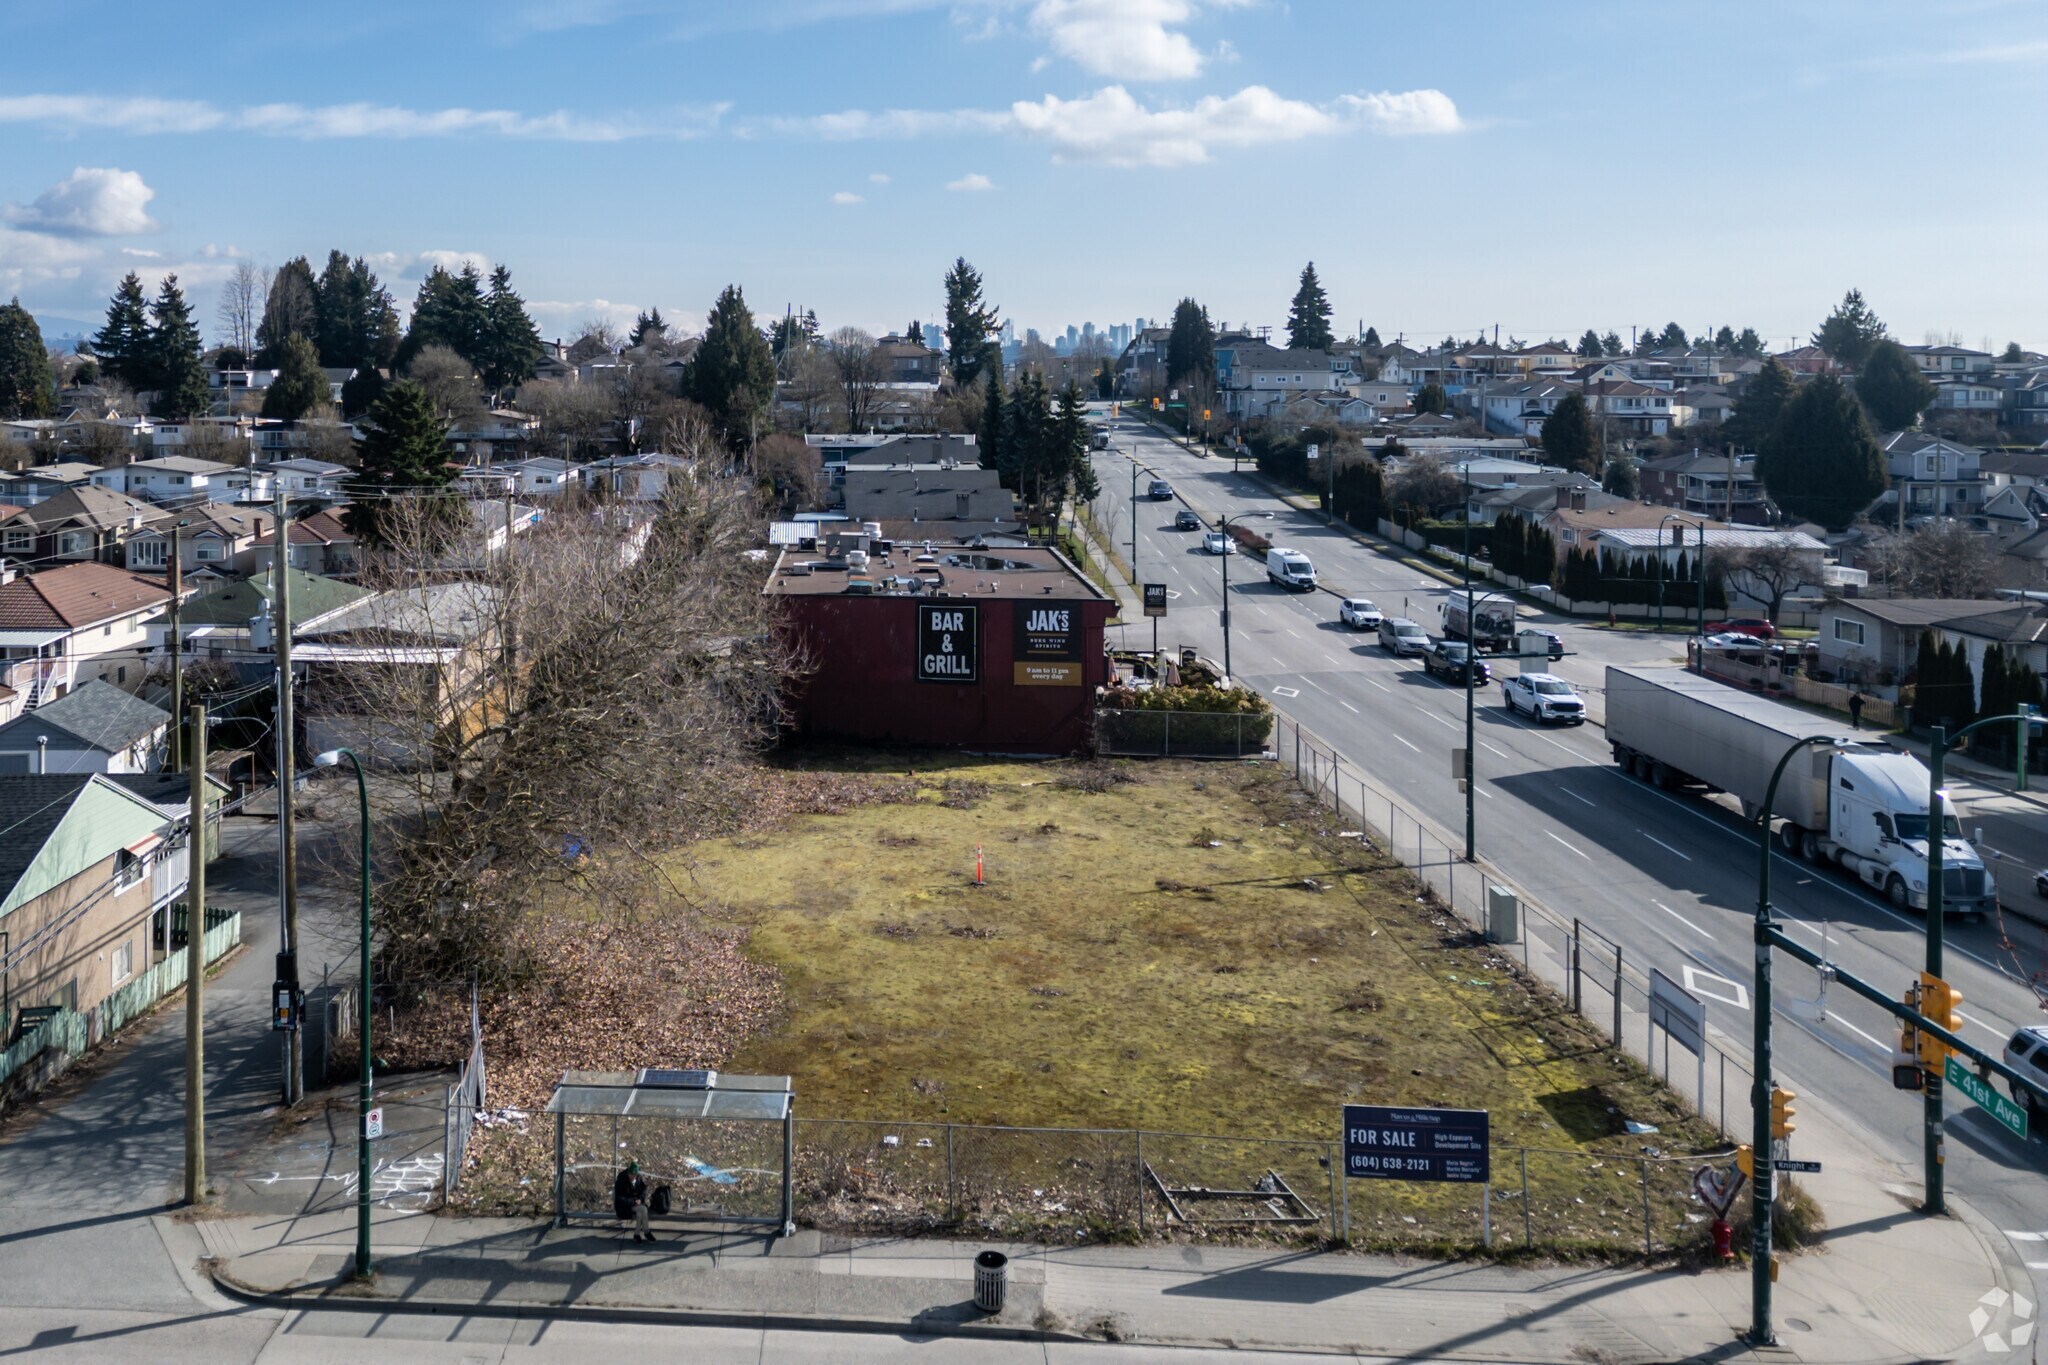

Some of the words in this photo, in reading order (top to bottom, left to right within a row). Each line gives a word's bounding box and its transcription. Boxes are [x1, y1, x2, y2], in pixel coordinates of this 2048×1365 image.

[932, 612, 964, 631] BAR
[1026, 610, 1069, 631] JAK'S
[942, 634, 953, 653] &
[924, 654, 970, 674] GRILL
[1949, 1064, 1958, 1083] E
[1963, 1076, 1990, 1107] 41st
[1995, 1099, 2020, 1129] Ave
[1350, 1129, 1377, 1145] FOR
[1382, 1130, 1416, 1147] SALE
[1434, 1141, 1469, 1150] Development
[1470, 1142, 1481, 1150] Site
[1351, 1155, 1379, 1170] (604)
[1382, 1157, 1430, 1171] 638-2121
[1778, 1161, 1805, 1171] Knight
